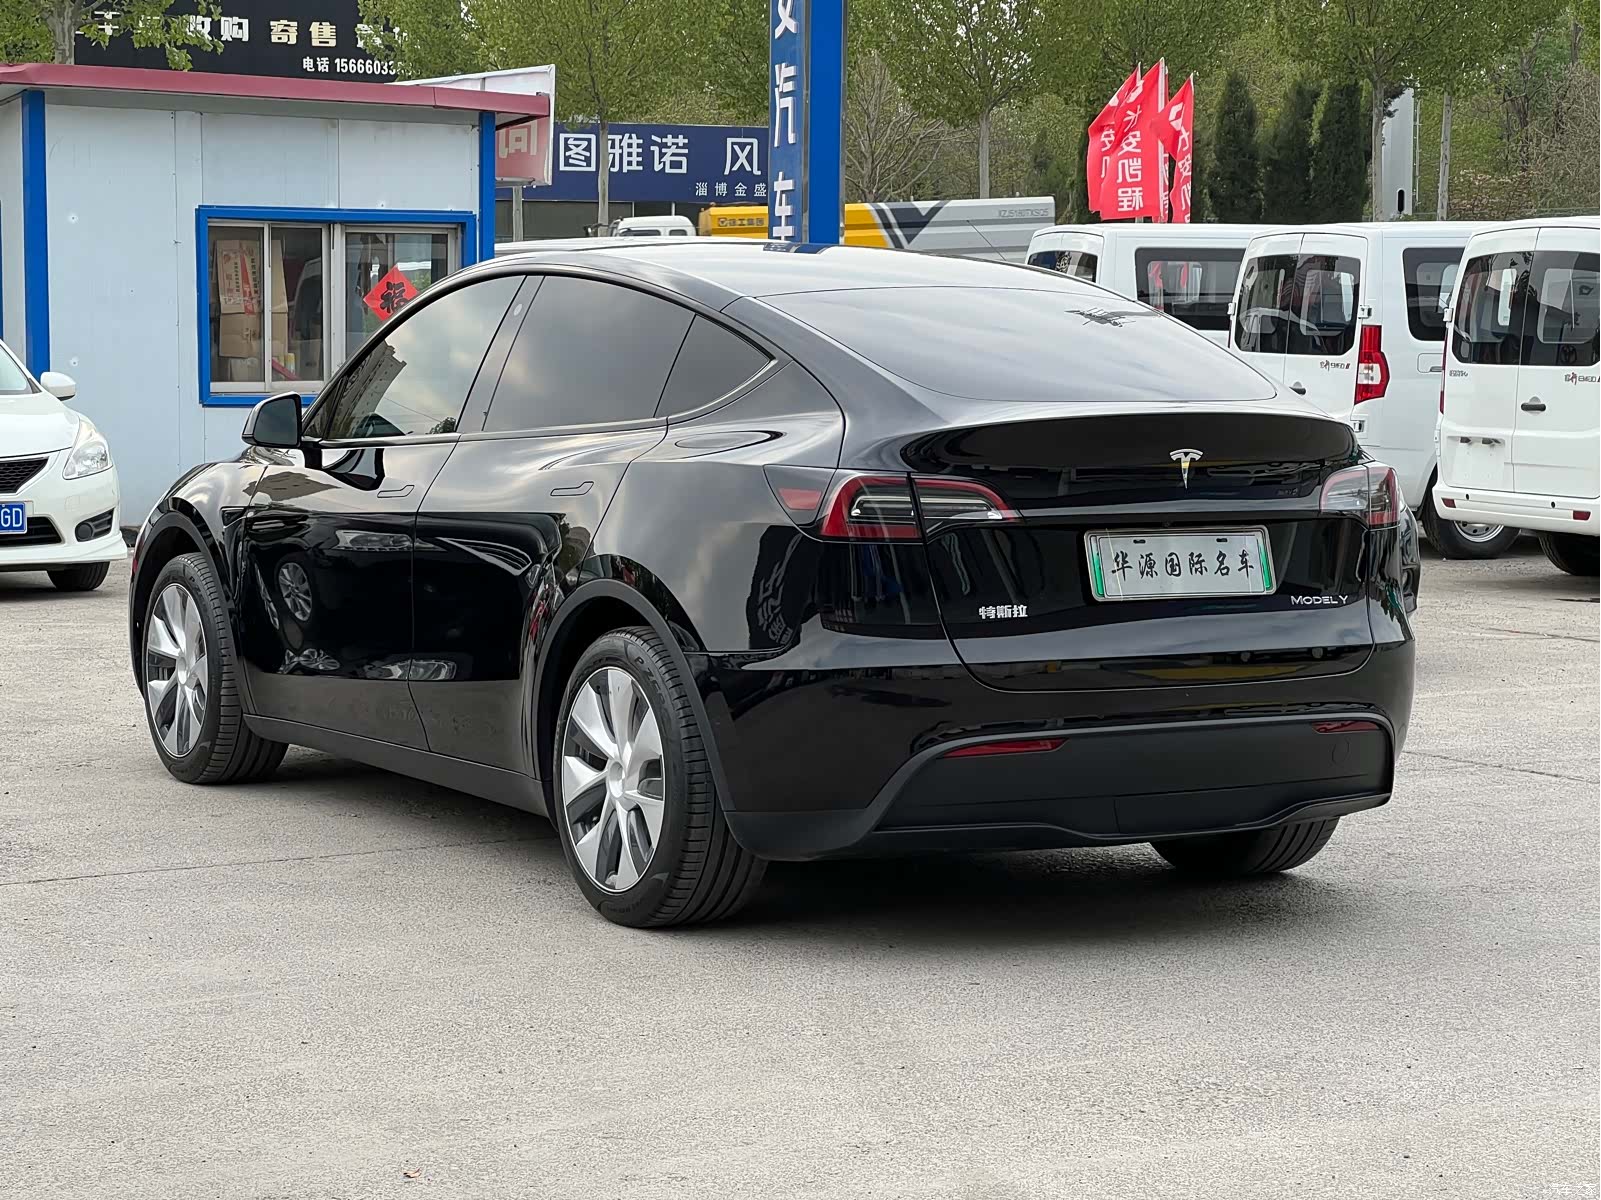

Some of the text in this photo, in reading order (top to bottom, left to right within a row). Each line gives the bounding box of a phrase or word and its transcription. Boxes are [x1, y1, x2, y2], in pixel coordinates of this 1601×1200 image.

[269, 19, 337, 47] 寄售
[302, 56, 330, 73] 电话
[559, 132, 762, 176] 图雅诺 风
[695, 182, 767, 198] 淄博金盛
[1111, 549, 1255, 581] 华源国际名车
[978, 604, 1028, 619] 特斯拉
